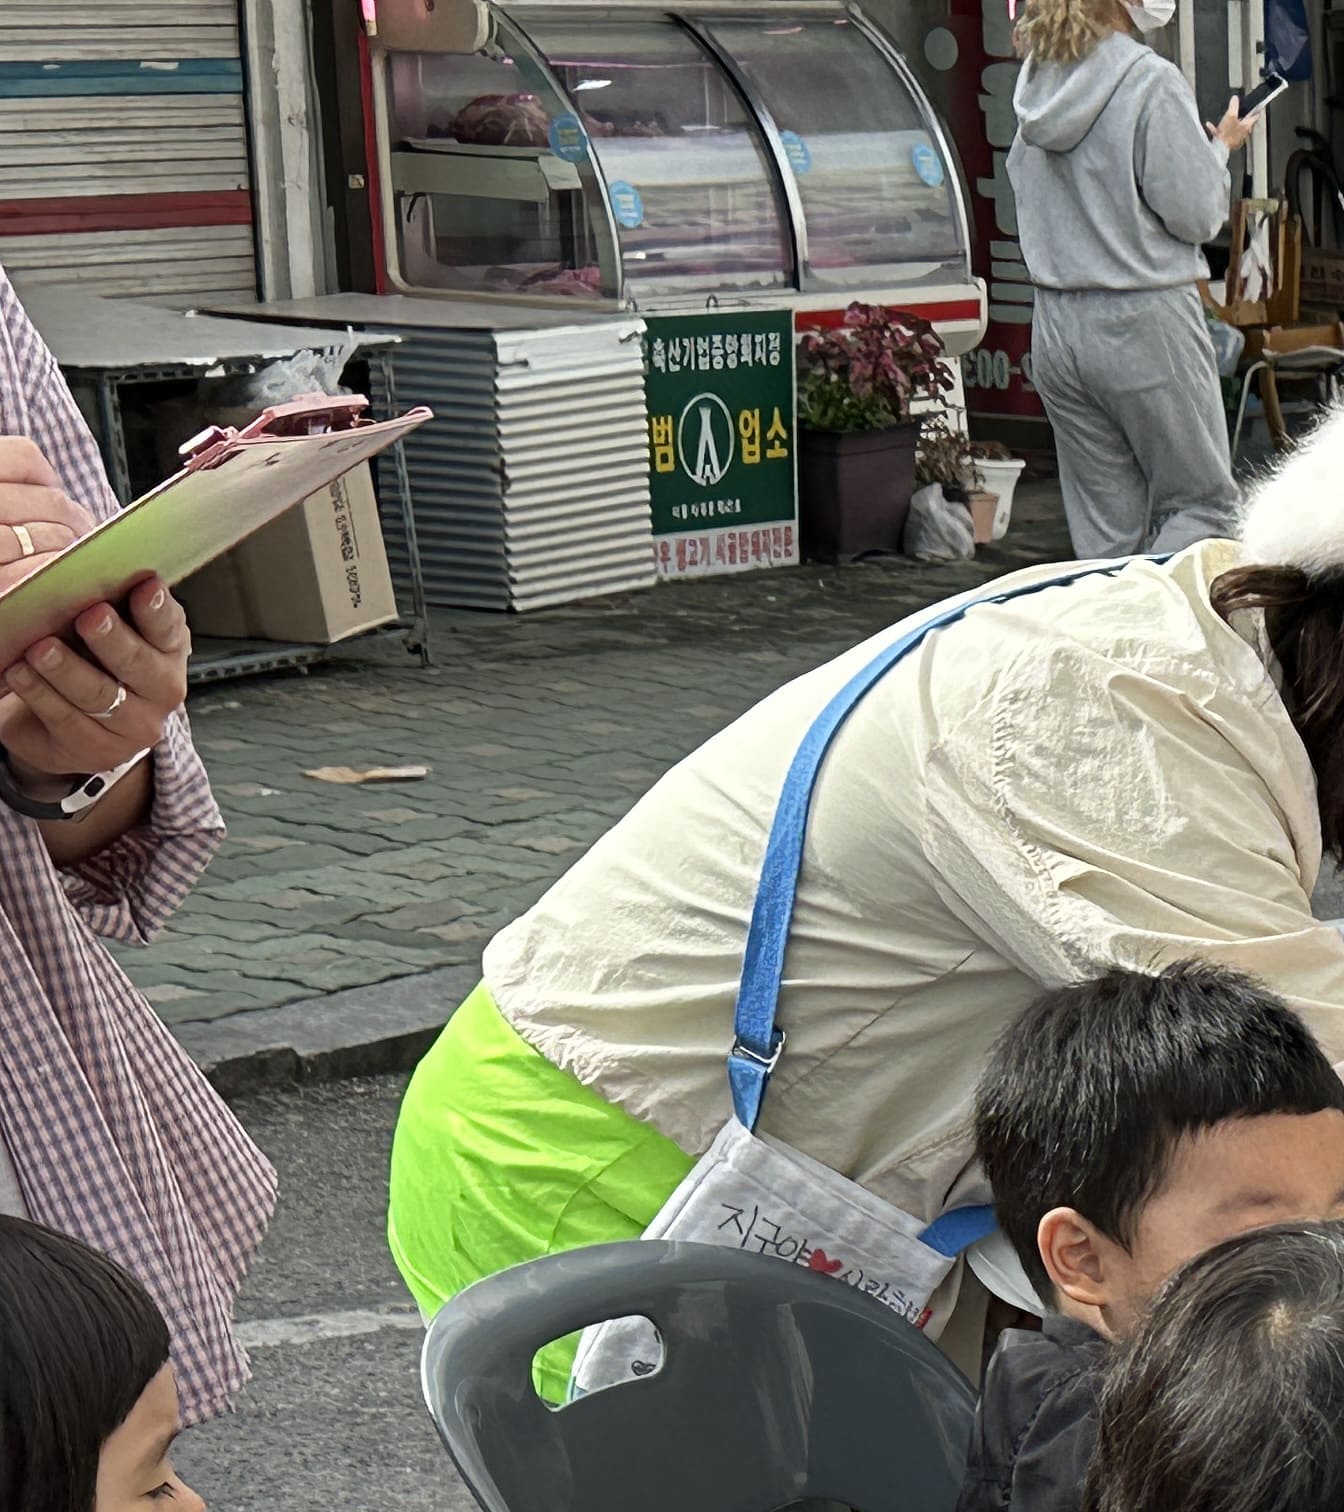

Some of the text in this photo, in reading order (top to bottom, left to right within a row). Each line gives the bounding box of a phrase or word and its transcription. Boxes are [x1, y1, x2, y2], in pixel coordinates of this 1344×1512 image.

[651, 405, 789, 473] 범 업소
[717, 1203, 813, 1264] 지구야
